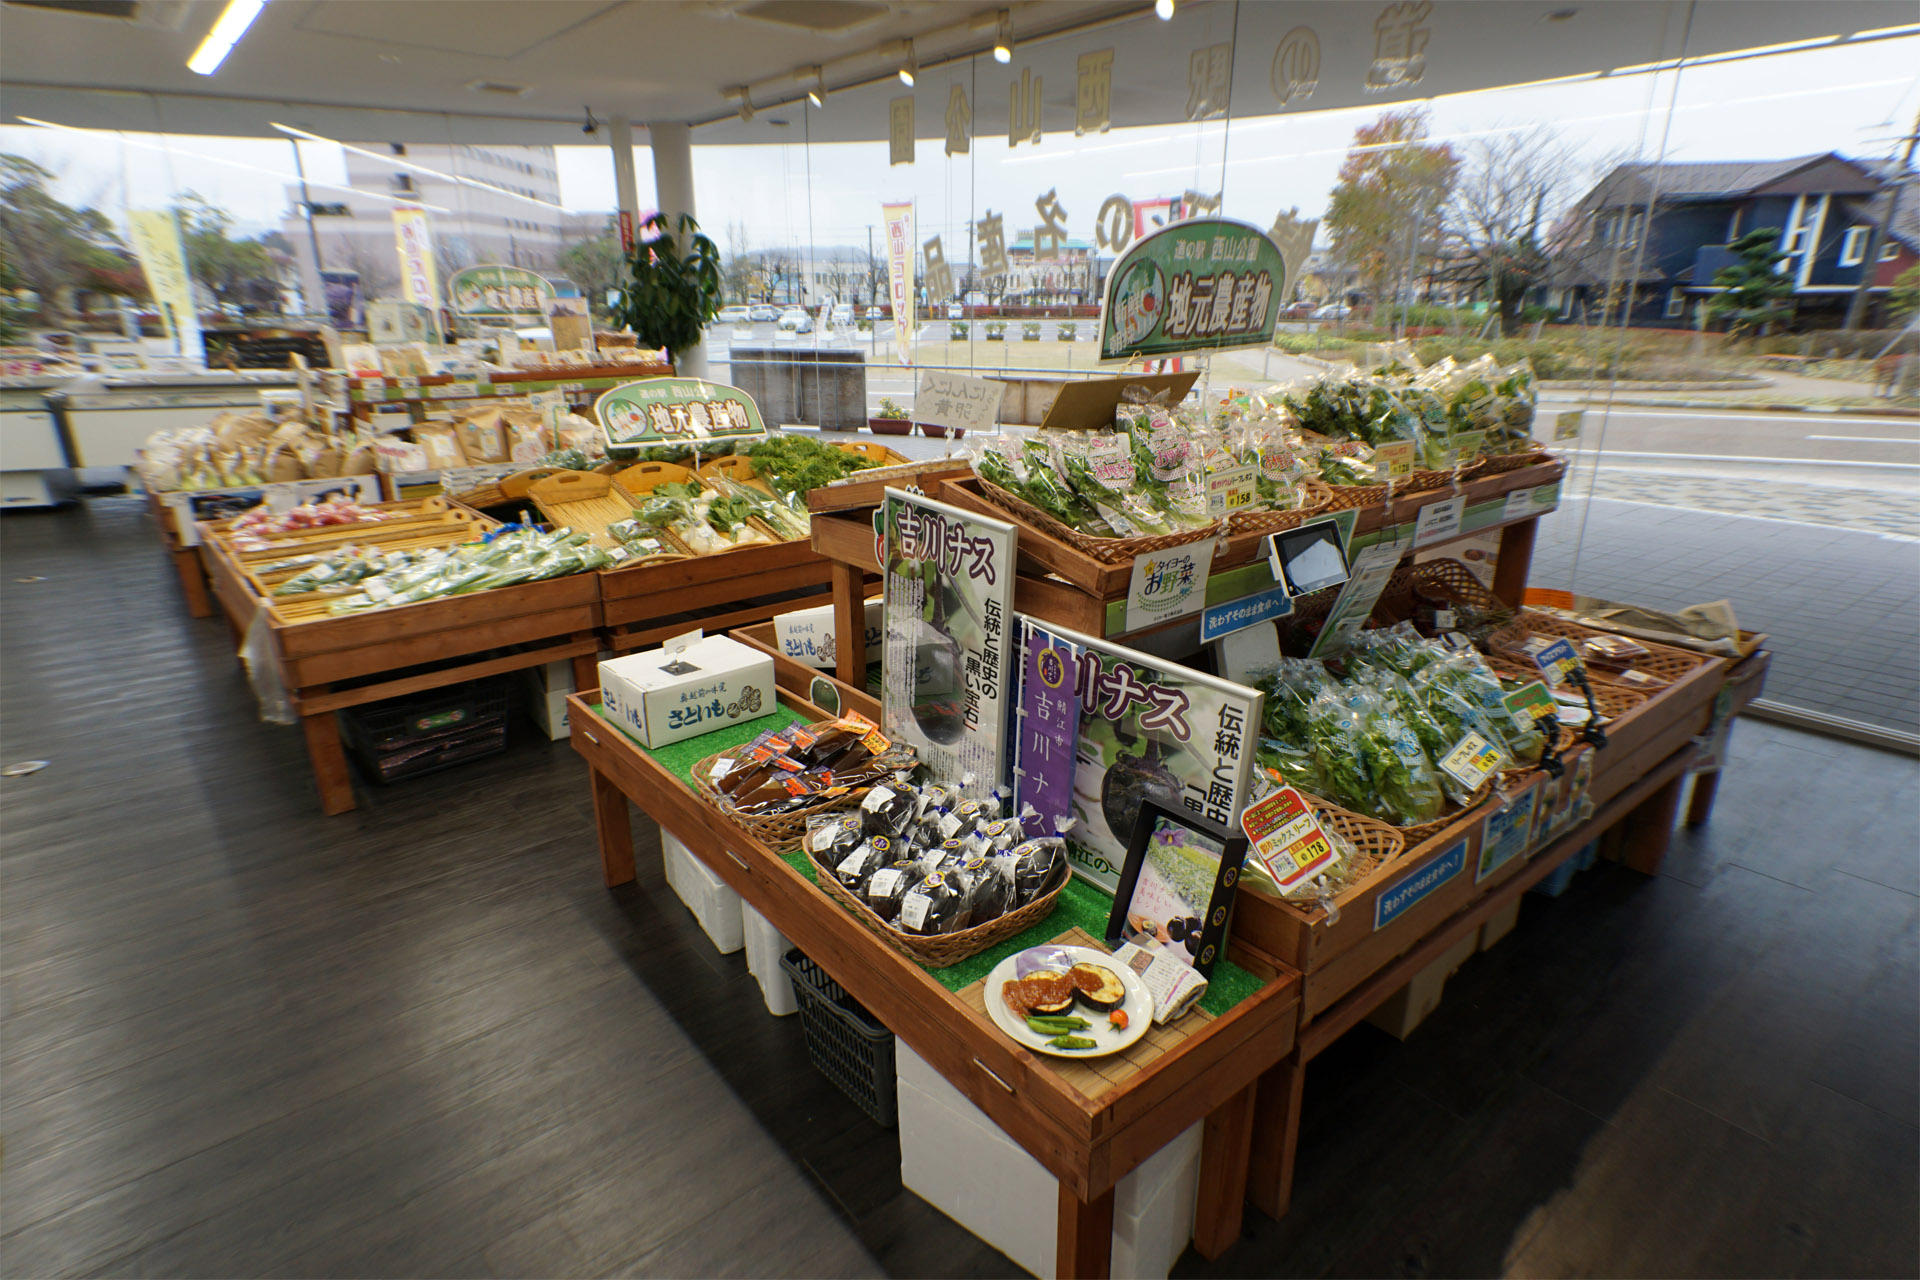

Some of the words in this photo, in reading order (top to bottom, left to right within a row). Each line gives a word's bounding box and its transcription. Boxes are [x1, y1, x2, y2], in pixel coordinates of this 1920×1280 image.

[1173, 239, 1206, 260] 道の駅
[1211, 235, 1261, 262] 西山公園
[1163, 270, 1274, 340] 地元農産物
[646, 399, 751, 435] 地元農産物
[896, 502, 996, 586] 吉川ナス
[1155, 554, 1191, 574] タイヨーの
[1144, 561, 1197, 596] お野菜
[785, 637, 817, 657] さといも
[982, 598, 1003, 700] 伝統と歴史の
[962, 648, 983, 732] 「黒い宝石」
[667, 698, 725, 730] さといも
[1054, 699, 1067, 748] 鯖江市
[1031, 690, 1054, 834] 吉川ナス
